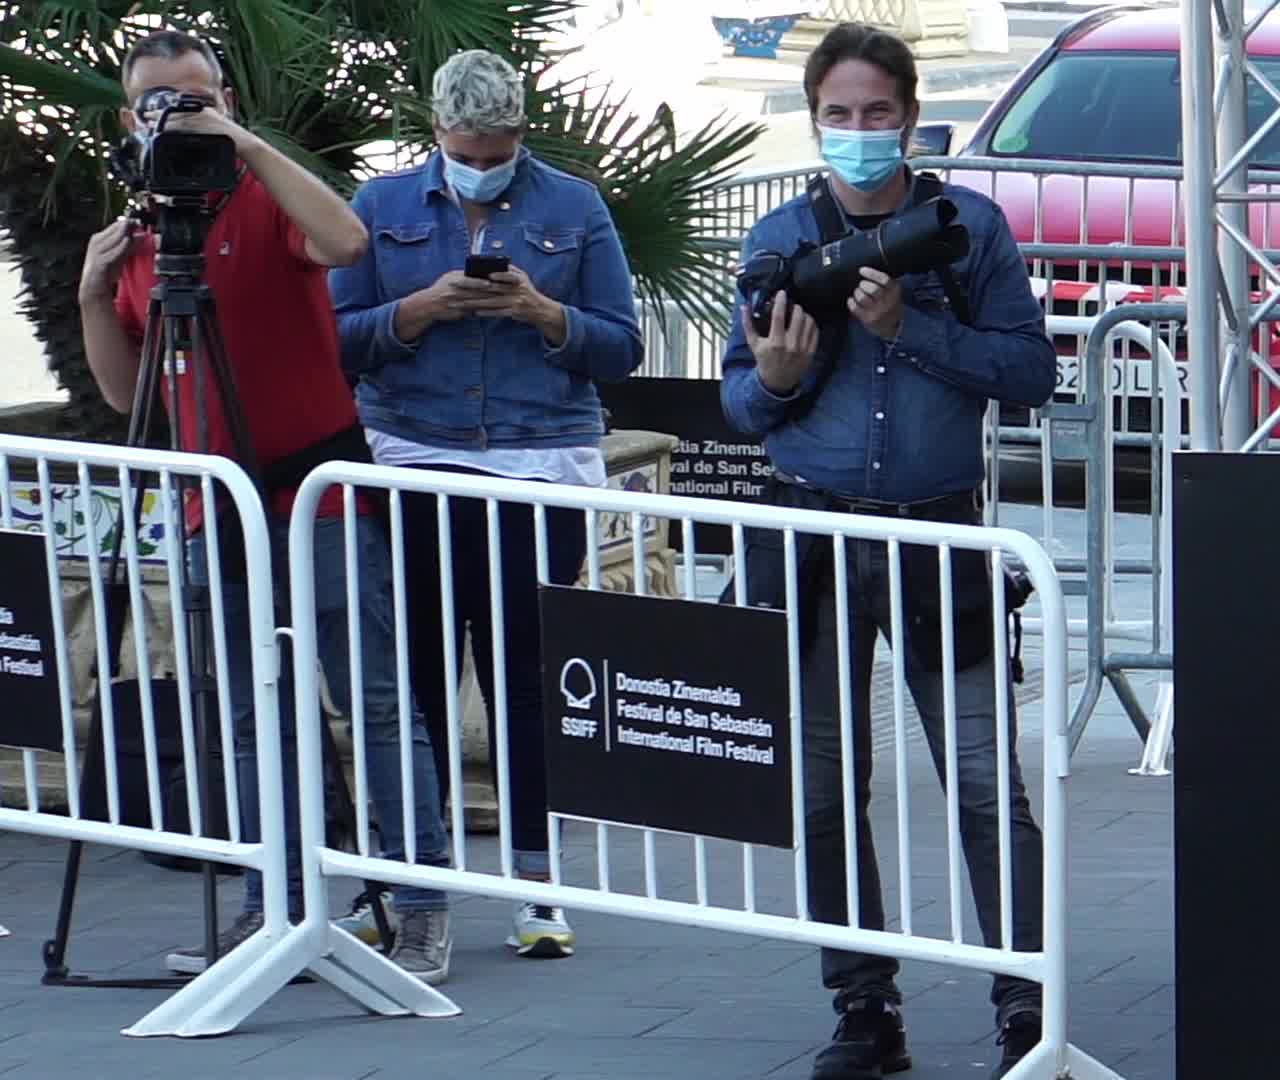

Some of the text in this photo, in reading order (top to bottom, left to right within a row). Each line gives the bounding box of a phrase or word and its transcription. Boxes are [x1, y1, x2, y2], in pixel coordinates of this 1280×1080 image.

[694, 460, 714, 475] de
[718, 460, 748, 476] San
[615, 672, 741, 708] Donostia Zinemaldia
[561, 717, 598, 739] SSIFF
[616, 699, 773, 738] Festival de San Sebastián
[617, 725, 774, 765] International Film Festival
